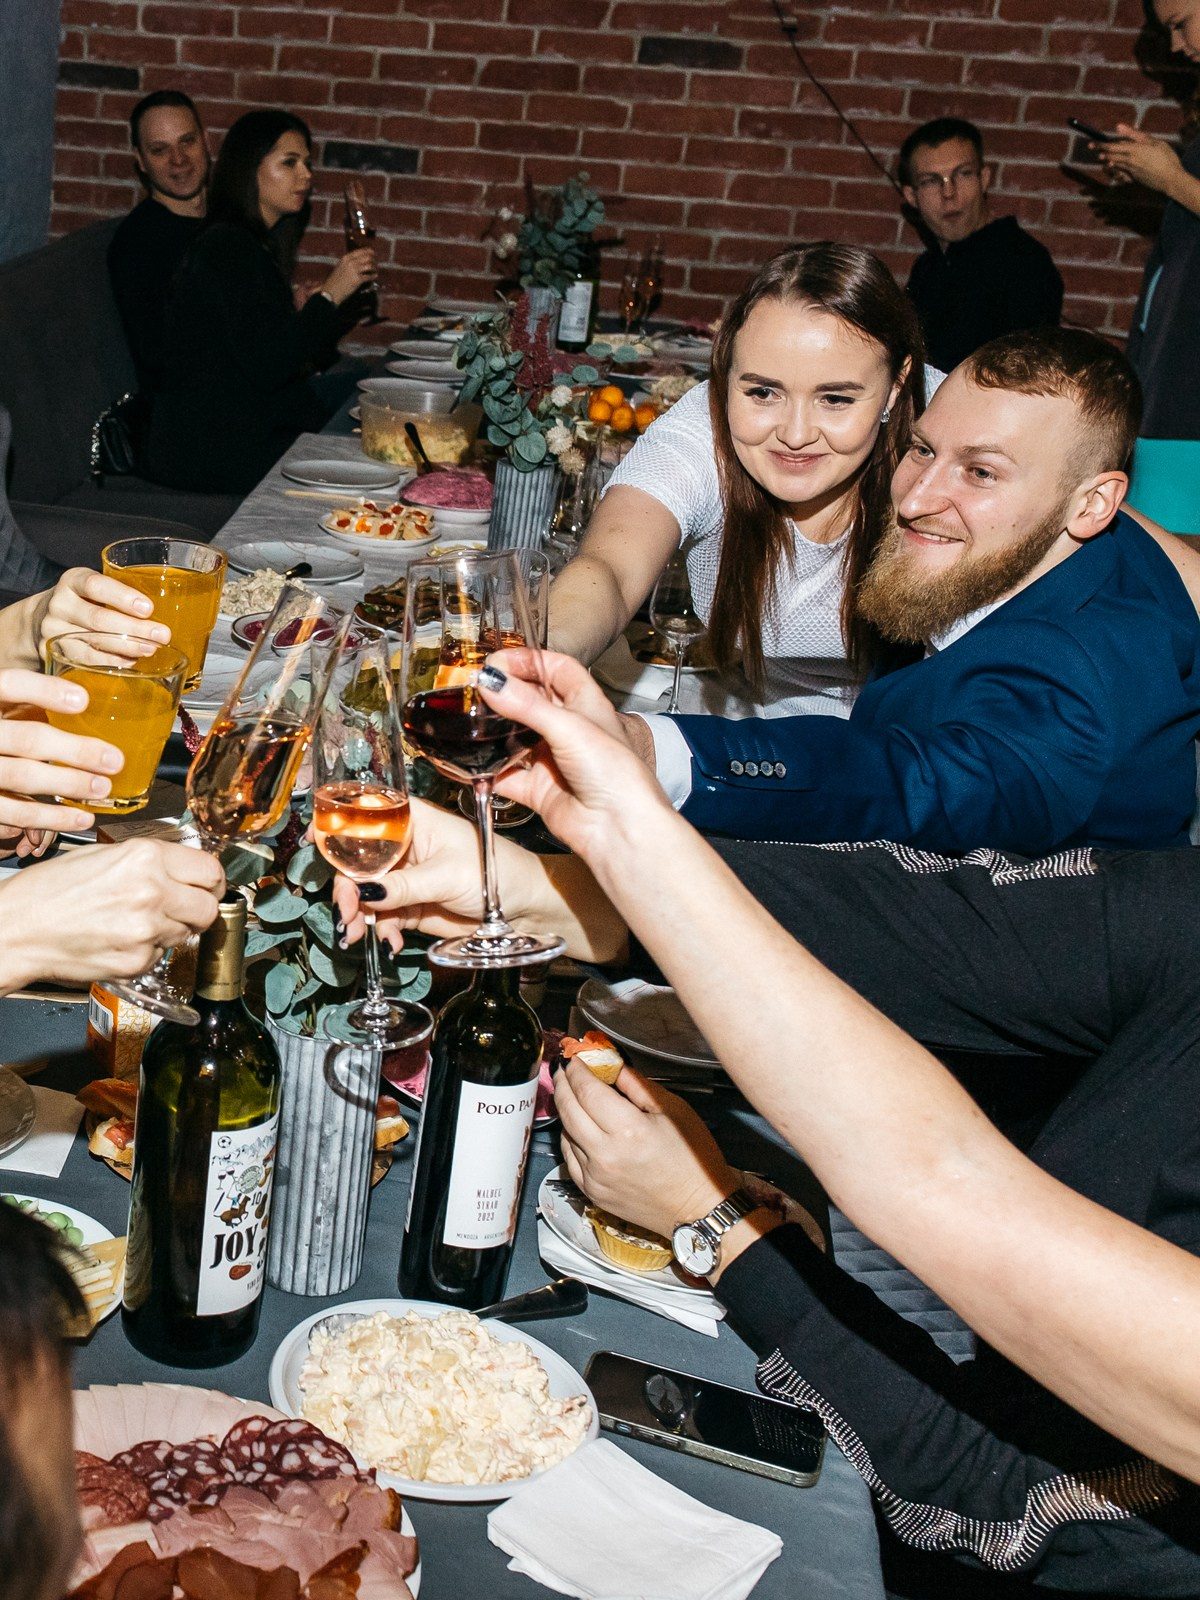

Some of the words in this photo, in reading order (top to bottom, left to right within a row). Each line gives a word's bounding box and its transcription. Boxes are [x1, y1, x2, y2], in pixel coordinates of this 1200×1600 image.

[477, 1101, 515, 1115] POLO
[251, 1191, 263, 1206] 10
[477, 1188, 502, 1199] MALBEC
[477, 1212, 495, 1222] 2023
[209, 1223, 259, 1269] JOY
